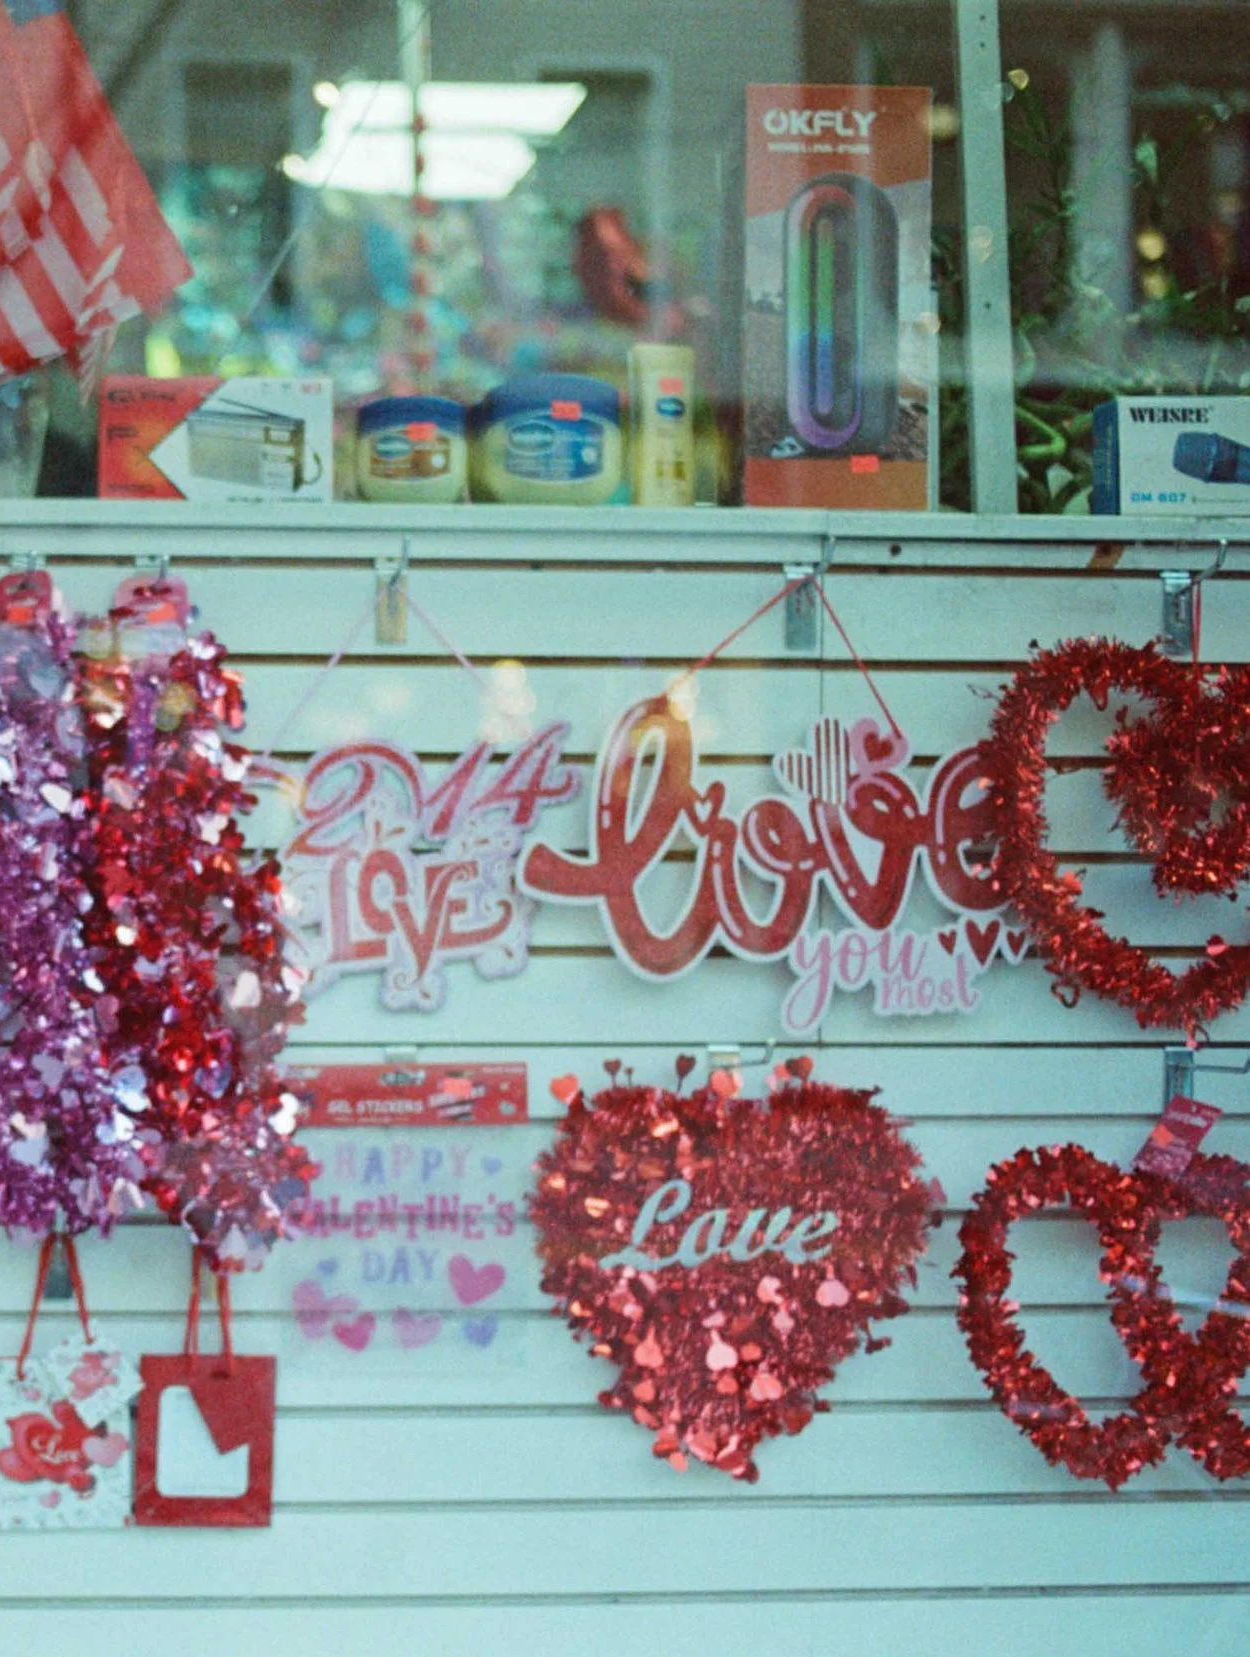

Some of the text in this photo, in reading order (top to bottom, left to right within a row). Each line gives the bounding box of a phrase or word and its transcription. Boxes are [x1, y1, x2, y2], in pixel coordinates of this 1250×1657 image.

[762, 107, 877, 137] OKFLY
[326, 849, 513, 982] LOVE
[784, 924, 928, 1032] you
[880, 952, 981, 1012] most
[333, 1142, 473, 1186] HAPPY
[598, 1179, 842, 1272] Love
[360, 1248, 440, 1284] DAY
